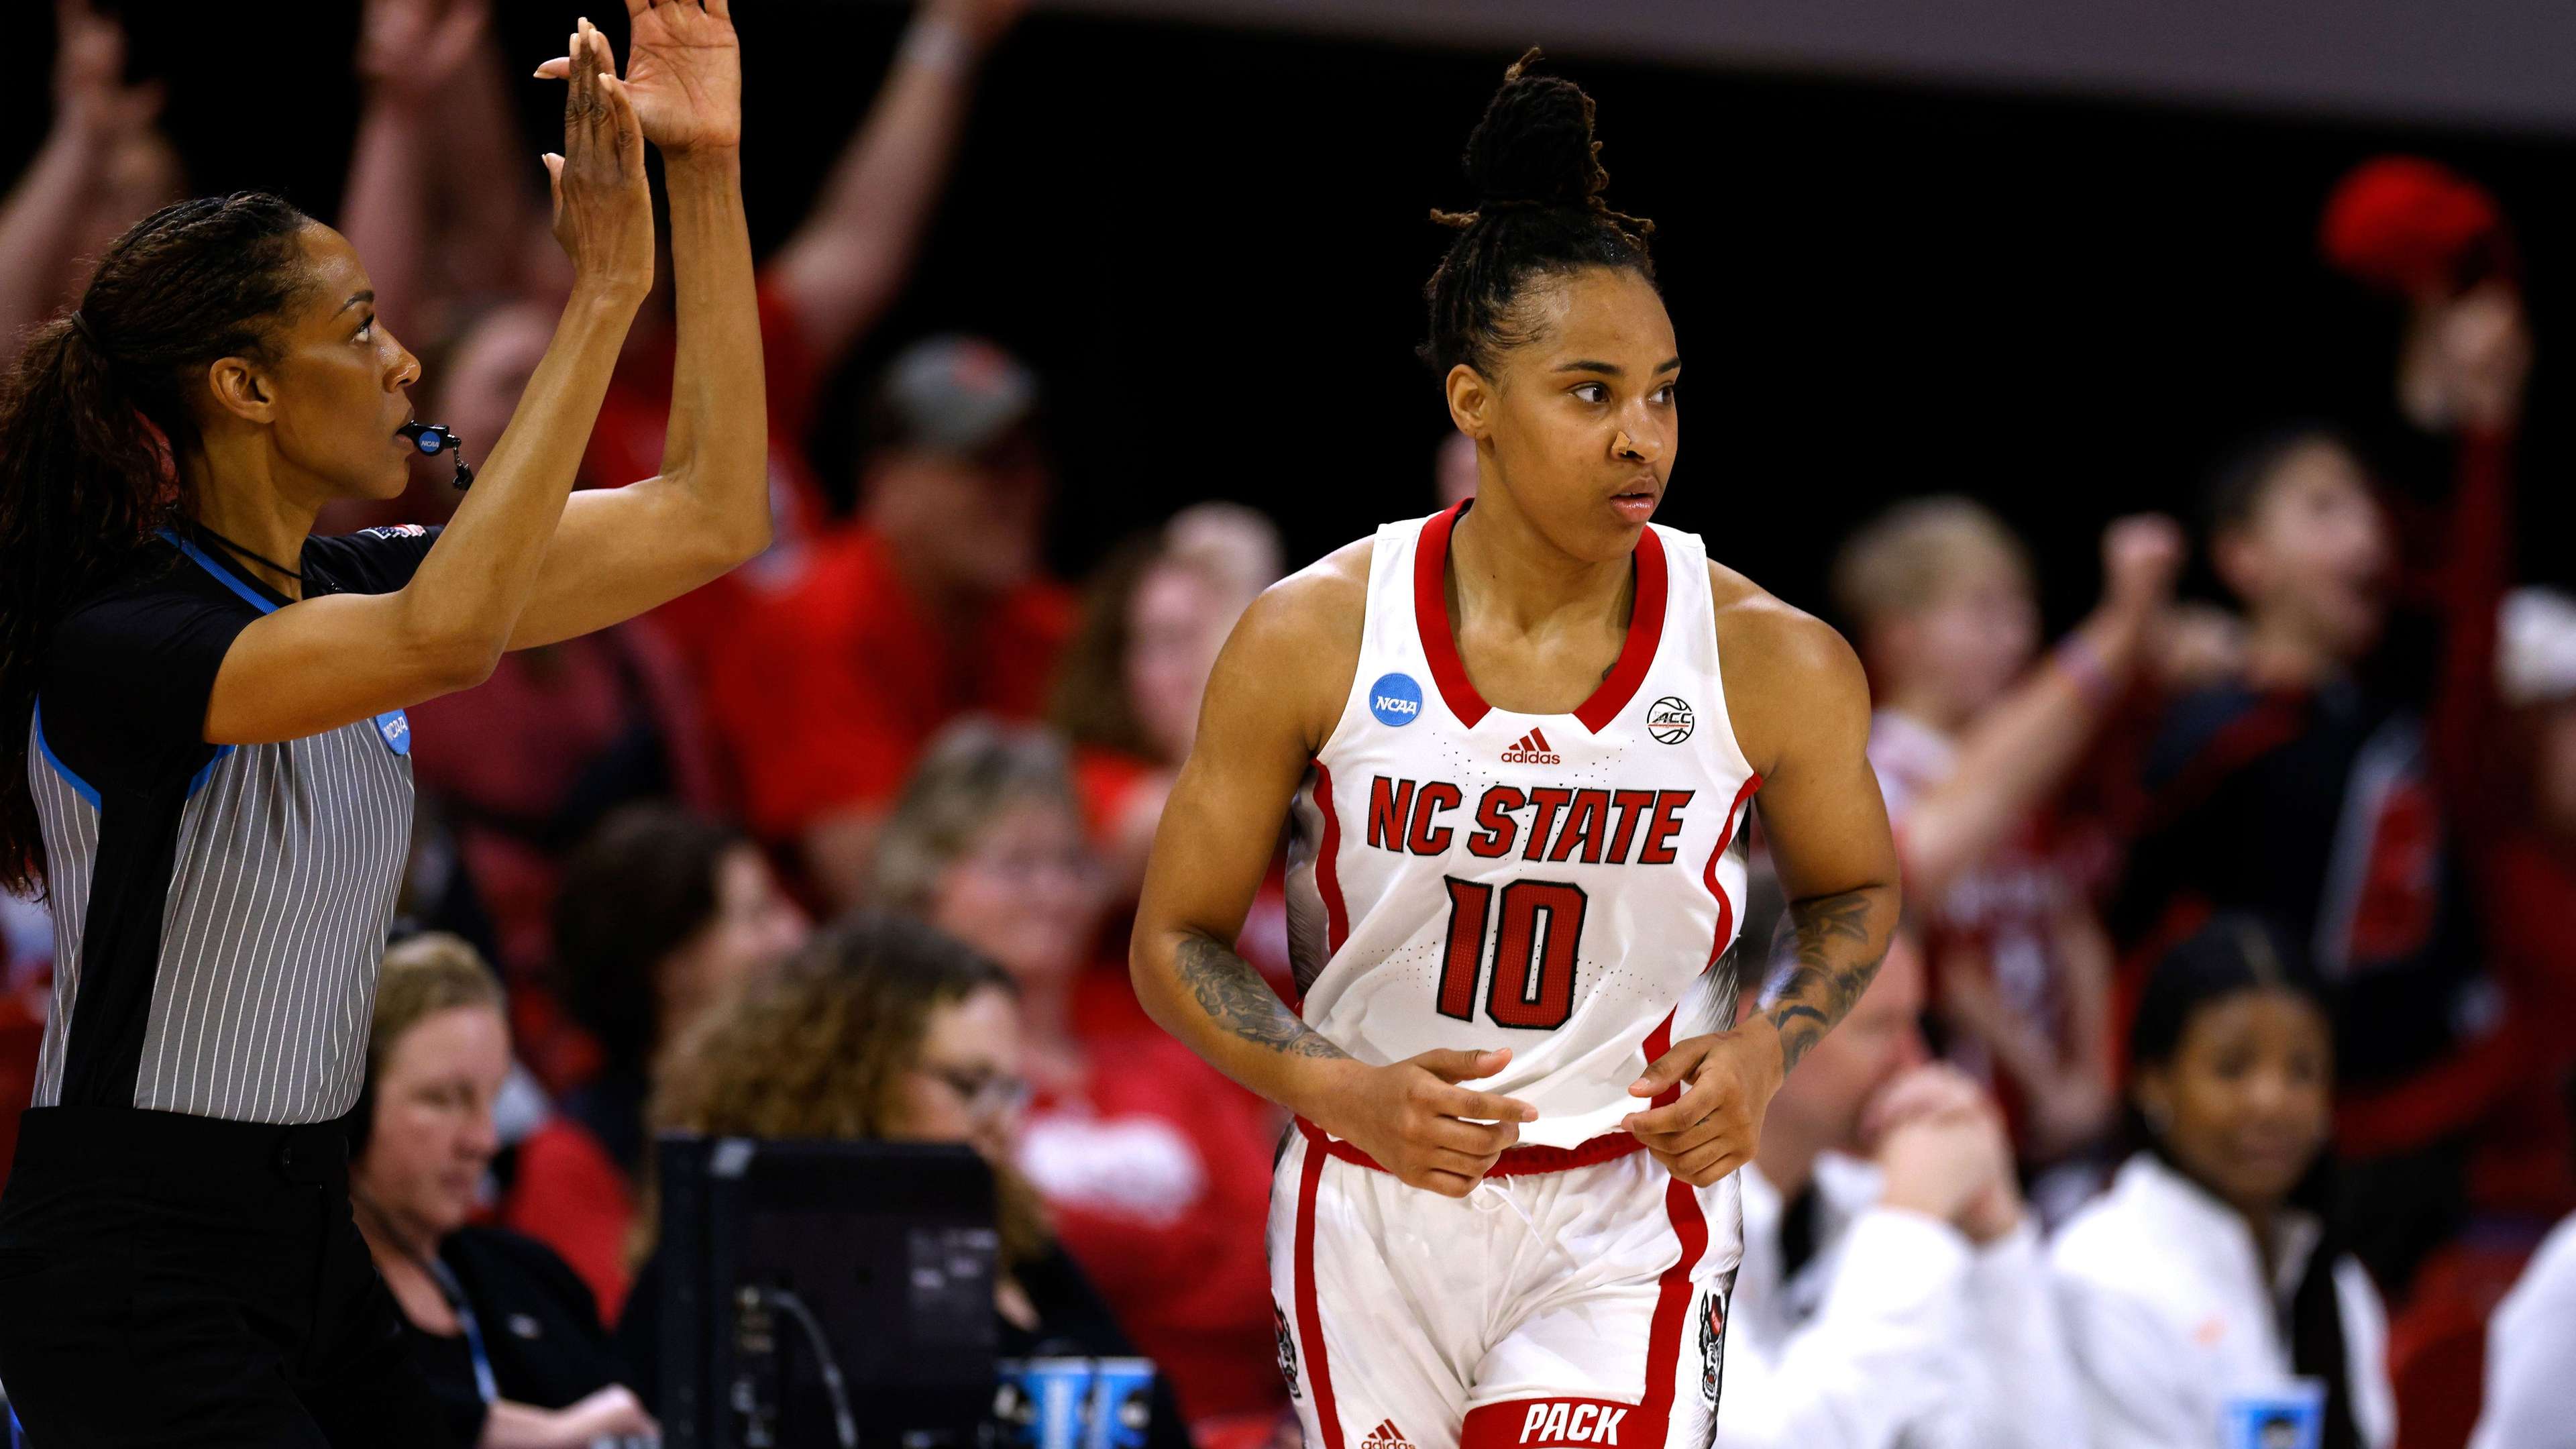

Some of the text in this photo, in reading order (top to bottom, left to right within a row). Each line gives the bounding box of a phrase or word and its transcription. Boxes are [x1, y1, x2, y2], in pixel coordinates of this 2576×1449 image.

[1375, 695, 1418, 715] NCAA
[384, 716, 409, 741] NCAA
[1652, 712, 1693, 724] ACC
[1501, 750, 1561, 765] adidas
[1367, 775, 1696, 865] NC STATE
[1436, 874, 1588, 1030] 10
[1519, 1402, 1628, 1446] PACK
